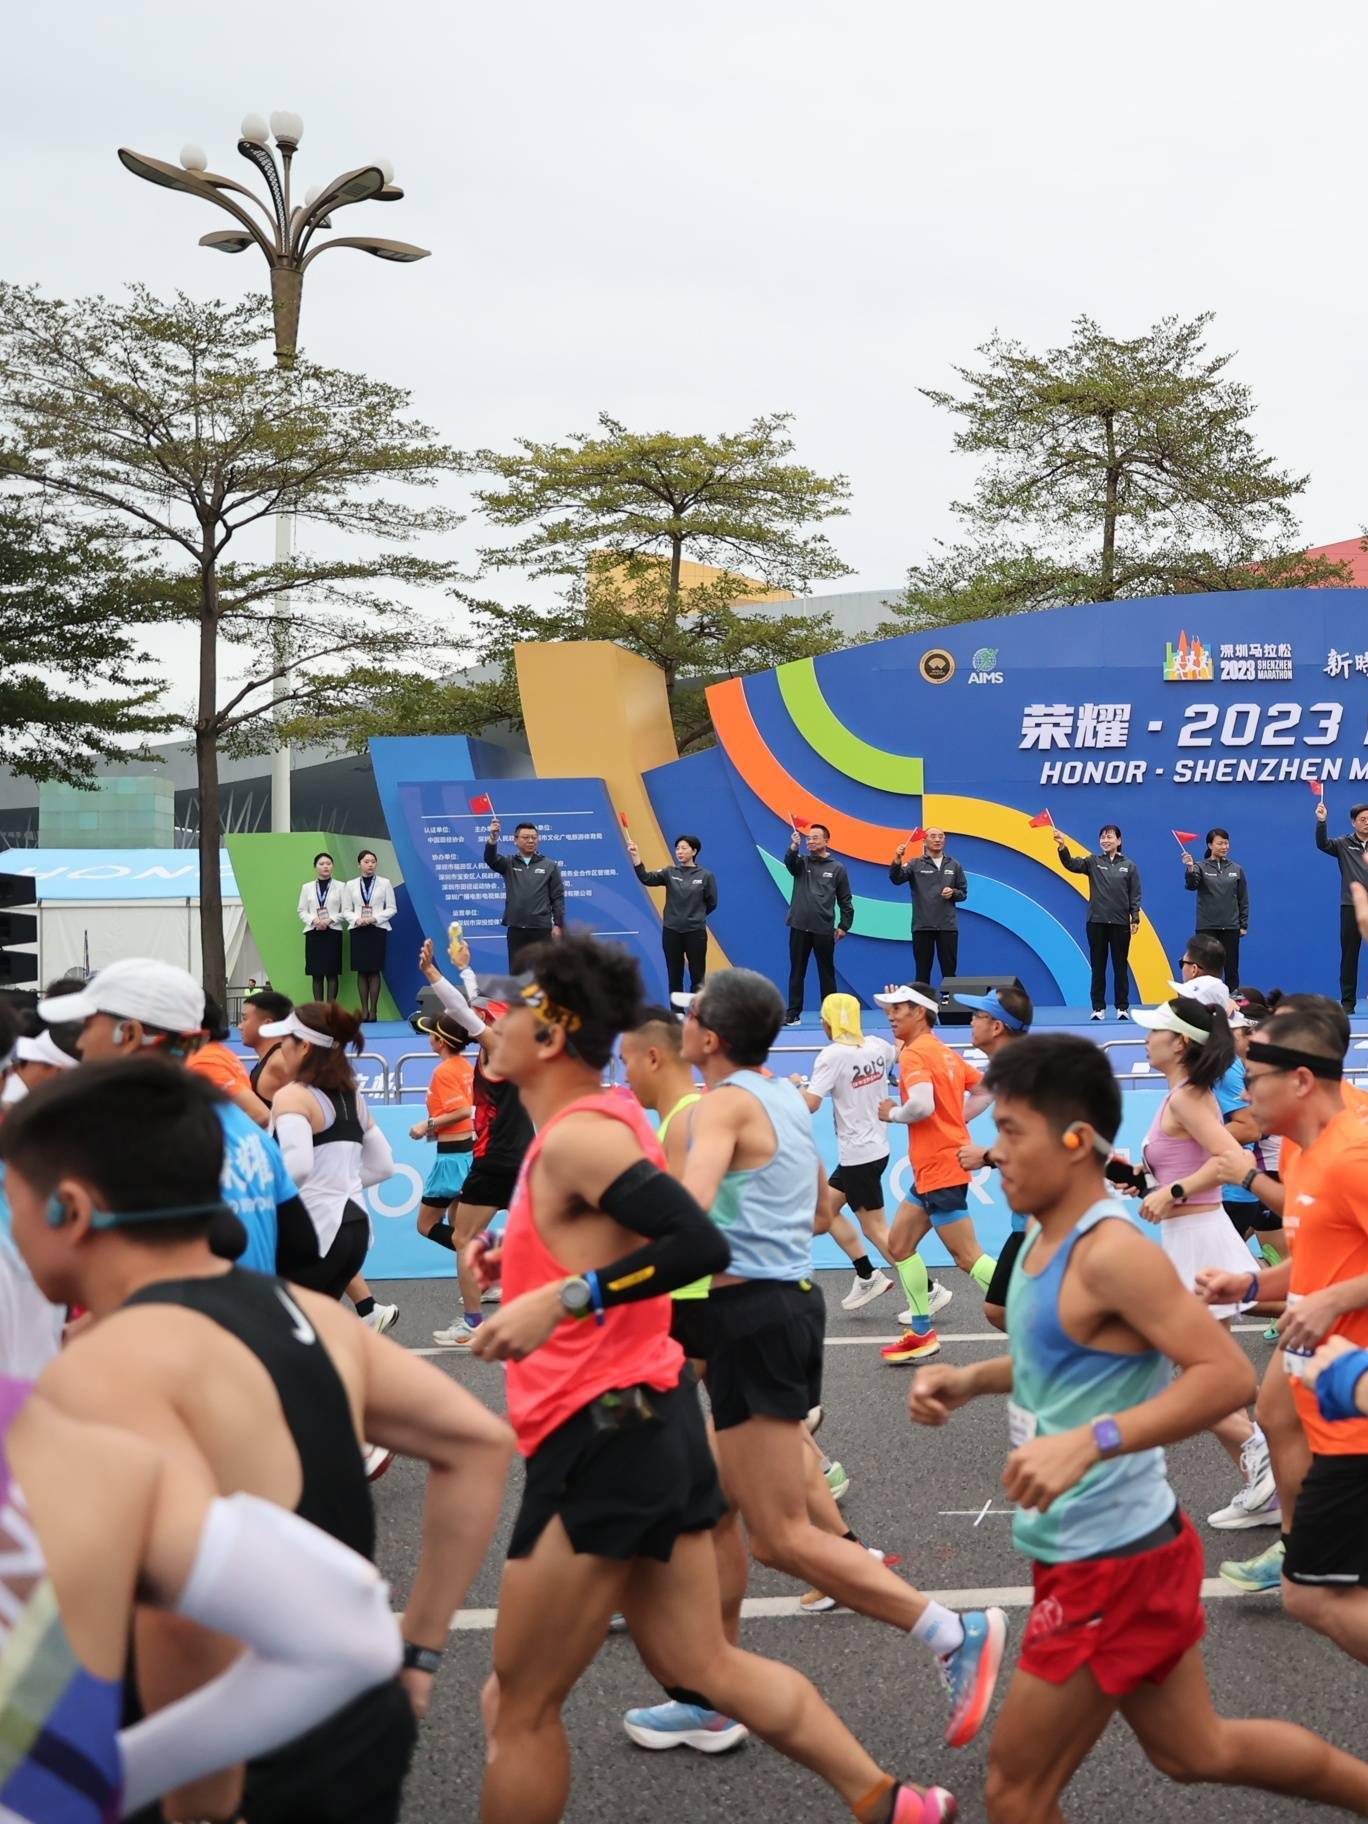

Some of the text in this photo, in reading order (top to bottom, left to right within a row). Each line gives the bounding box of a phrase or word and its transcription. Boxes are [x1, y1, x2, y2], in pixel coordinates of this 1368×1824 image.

[1220, 643, 1292, 658] 深圳马拉松
[1220, 660, 1256, 681] 2023
[1257, 659, 1292, 670] SHENZHEN
[967, 671, 1005, 685] AIMS
[1257, 670, 1293, 680] MARATHON
[1018, 702, 1132, 750] 荣耀
[1177, 702, 1344, 748] 2023
[1040, 760, 1148, 785] HONOR
[1172, 757, 1343, 784] SHENZHEN
